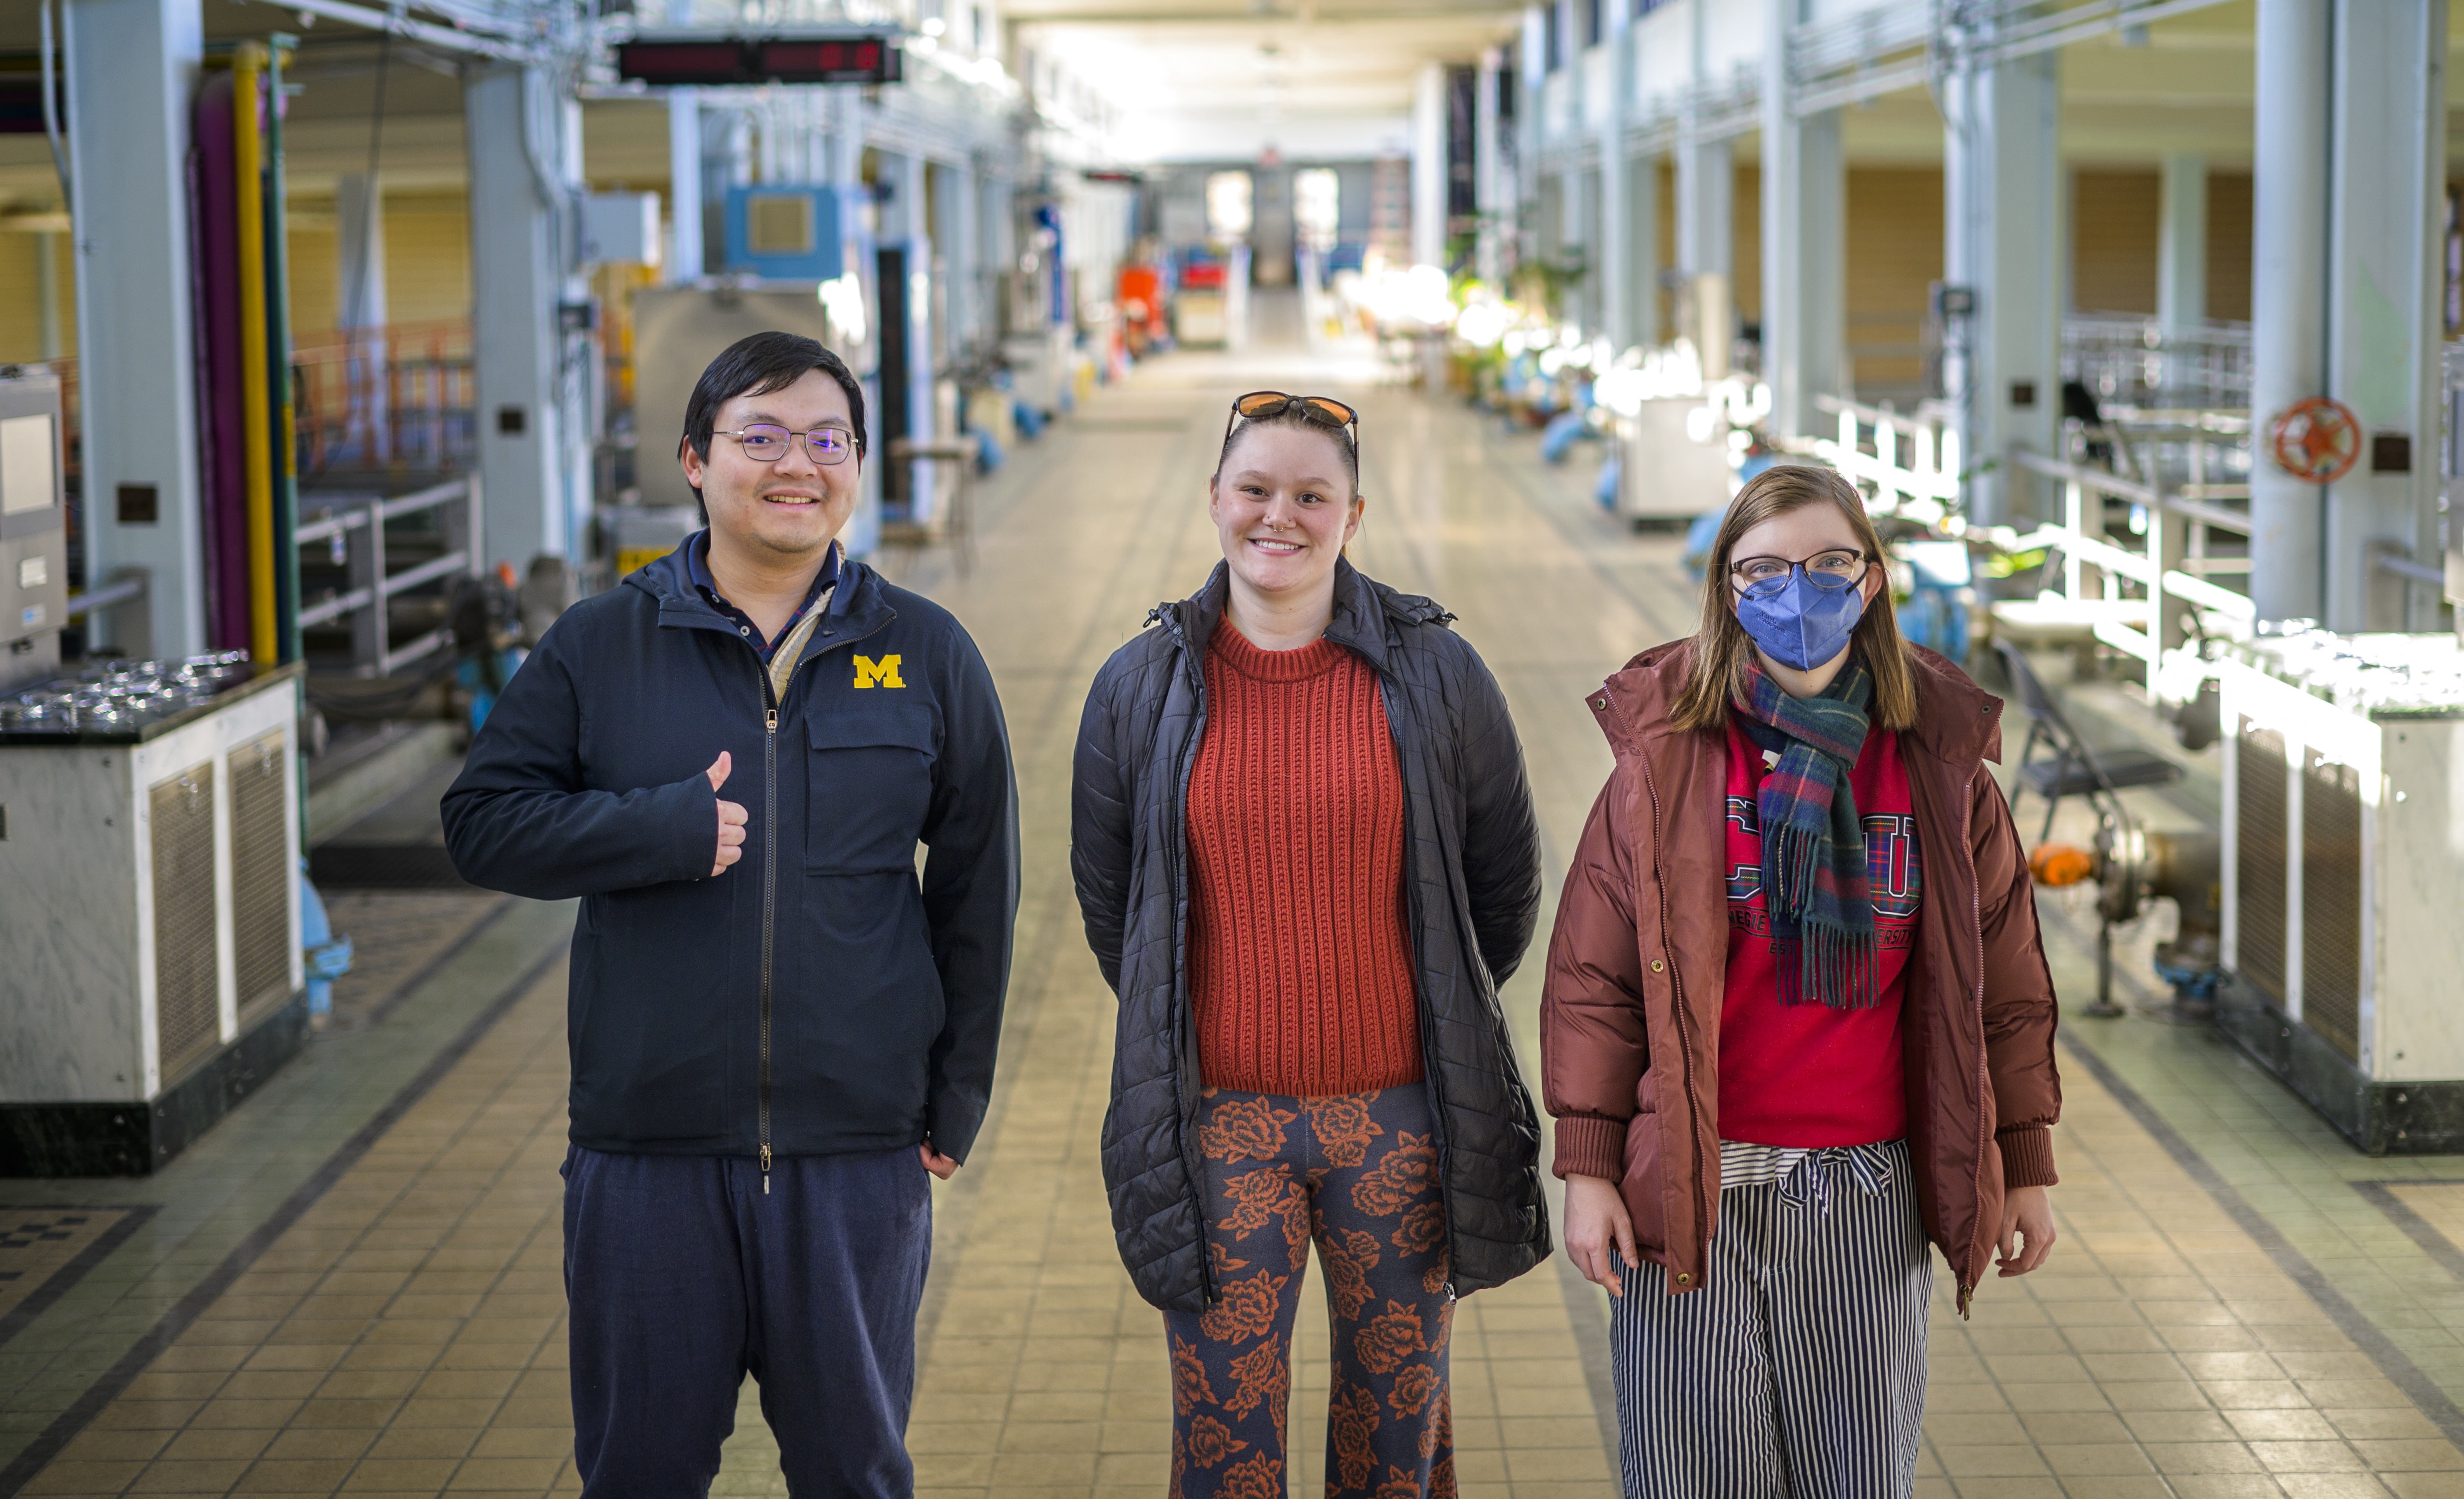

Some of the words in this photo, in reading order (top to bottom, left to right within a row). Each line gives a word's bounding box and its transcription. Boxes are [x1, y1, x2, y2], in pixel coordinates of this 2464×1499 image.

[853, 654, 903, 689] M
[1728, 909, 1766, 932] NEGIE
[1876, 928, 1913, 945] ERSITY
